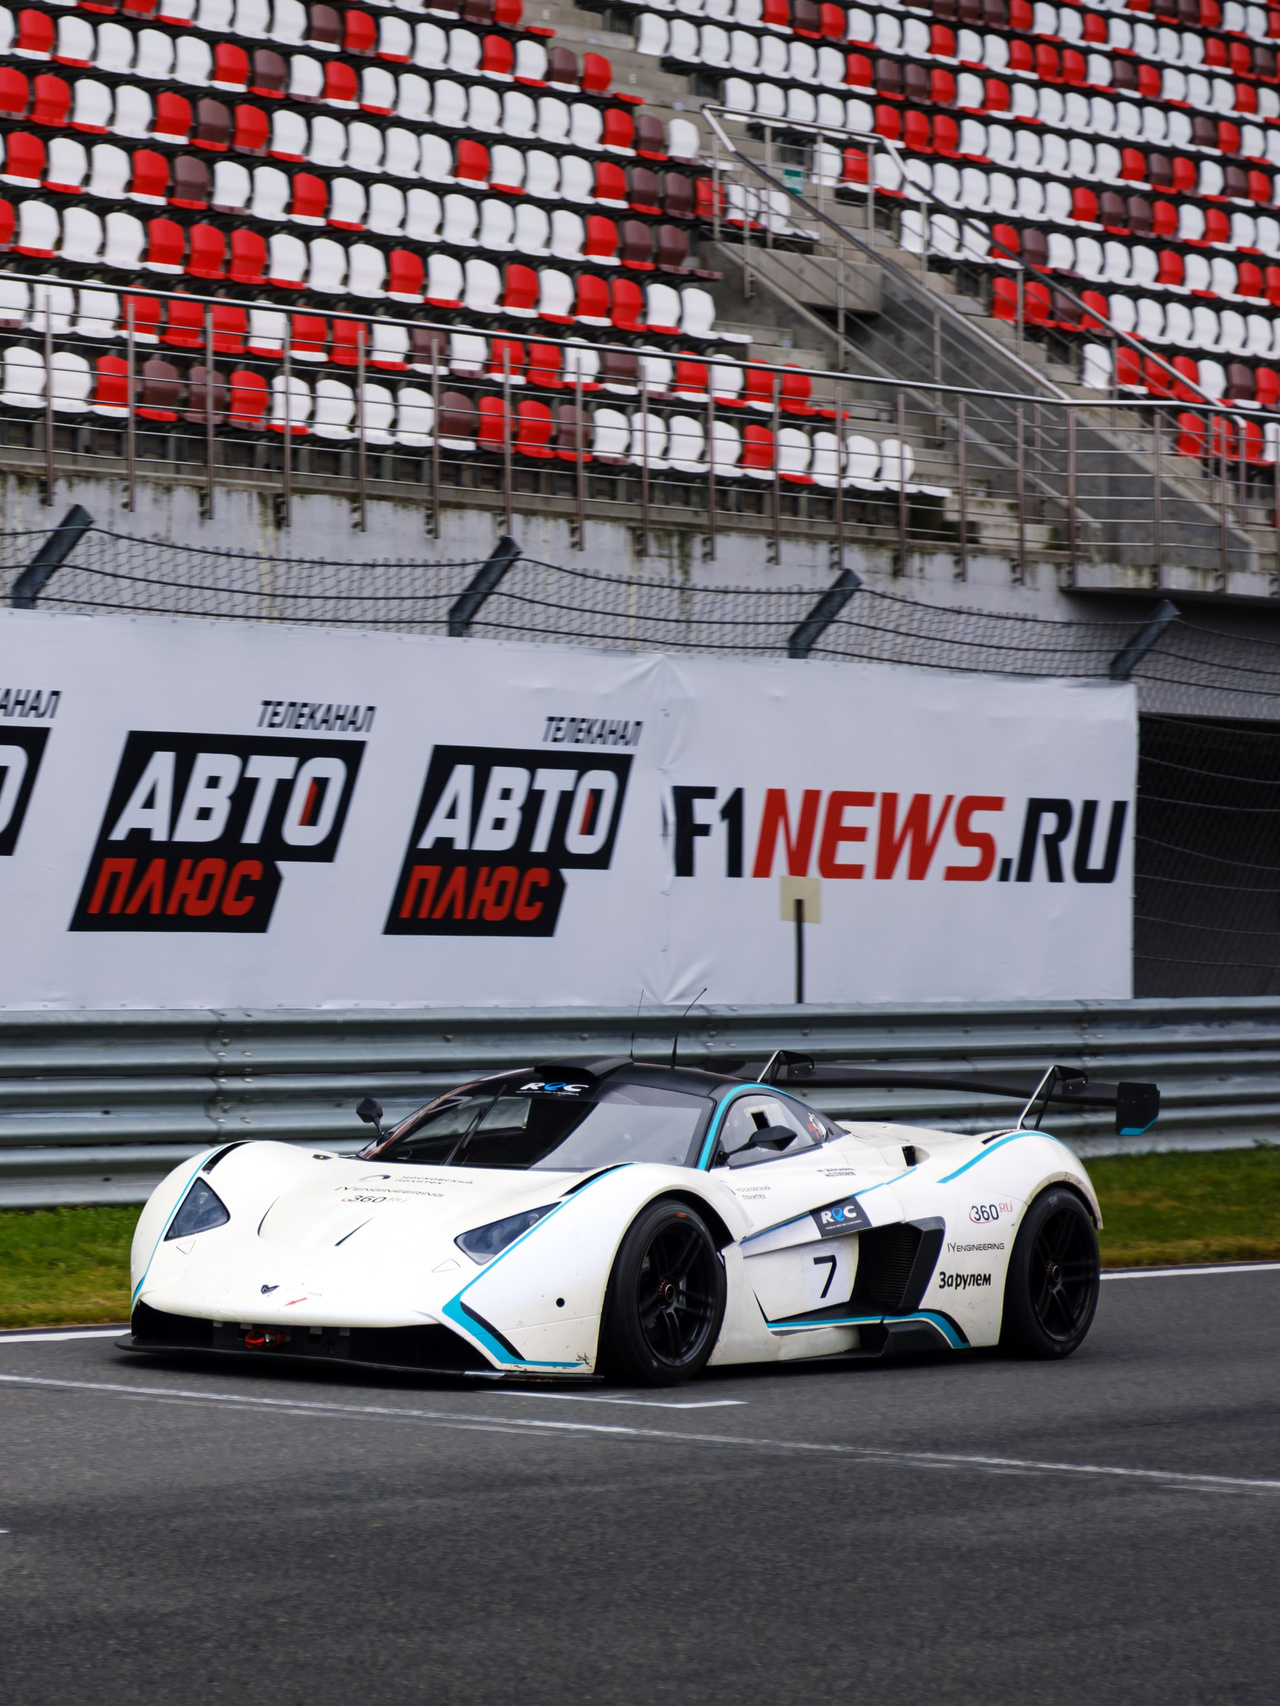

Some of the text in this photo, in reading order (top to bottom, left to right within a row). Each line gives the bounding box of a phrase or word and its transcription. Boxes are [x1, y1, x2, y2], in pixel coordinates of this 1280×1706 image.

[256, 700, 377, 733] ТЕЛЕКАНАЛ
[542, 716, 644, 747] ТЕЛЕКАНАЛ
[107, 750, 348, 847] АВТО
[417, 764, 619, 854] АВТО
[663, 786, 1128, 884] F1NEWS.RU
[86, 858, 264, 916] ПЛЮС
[399, 865, 551, 921] ПЛЮС
[813, 1254, 837, 1299] 7
